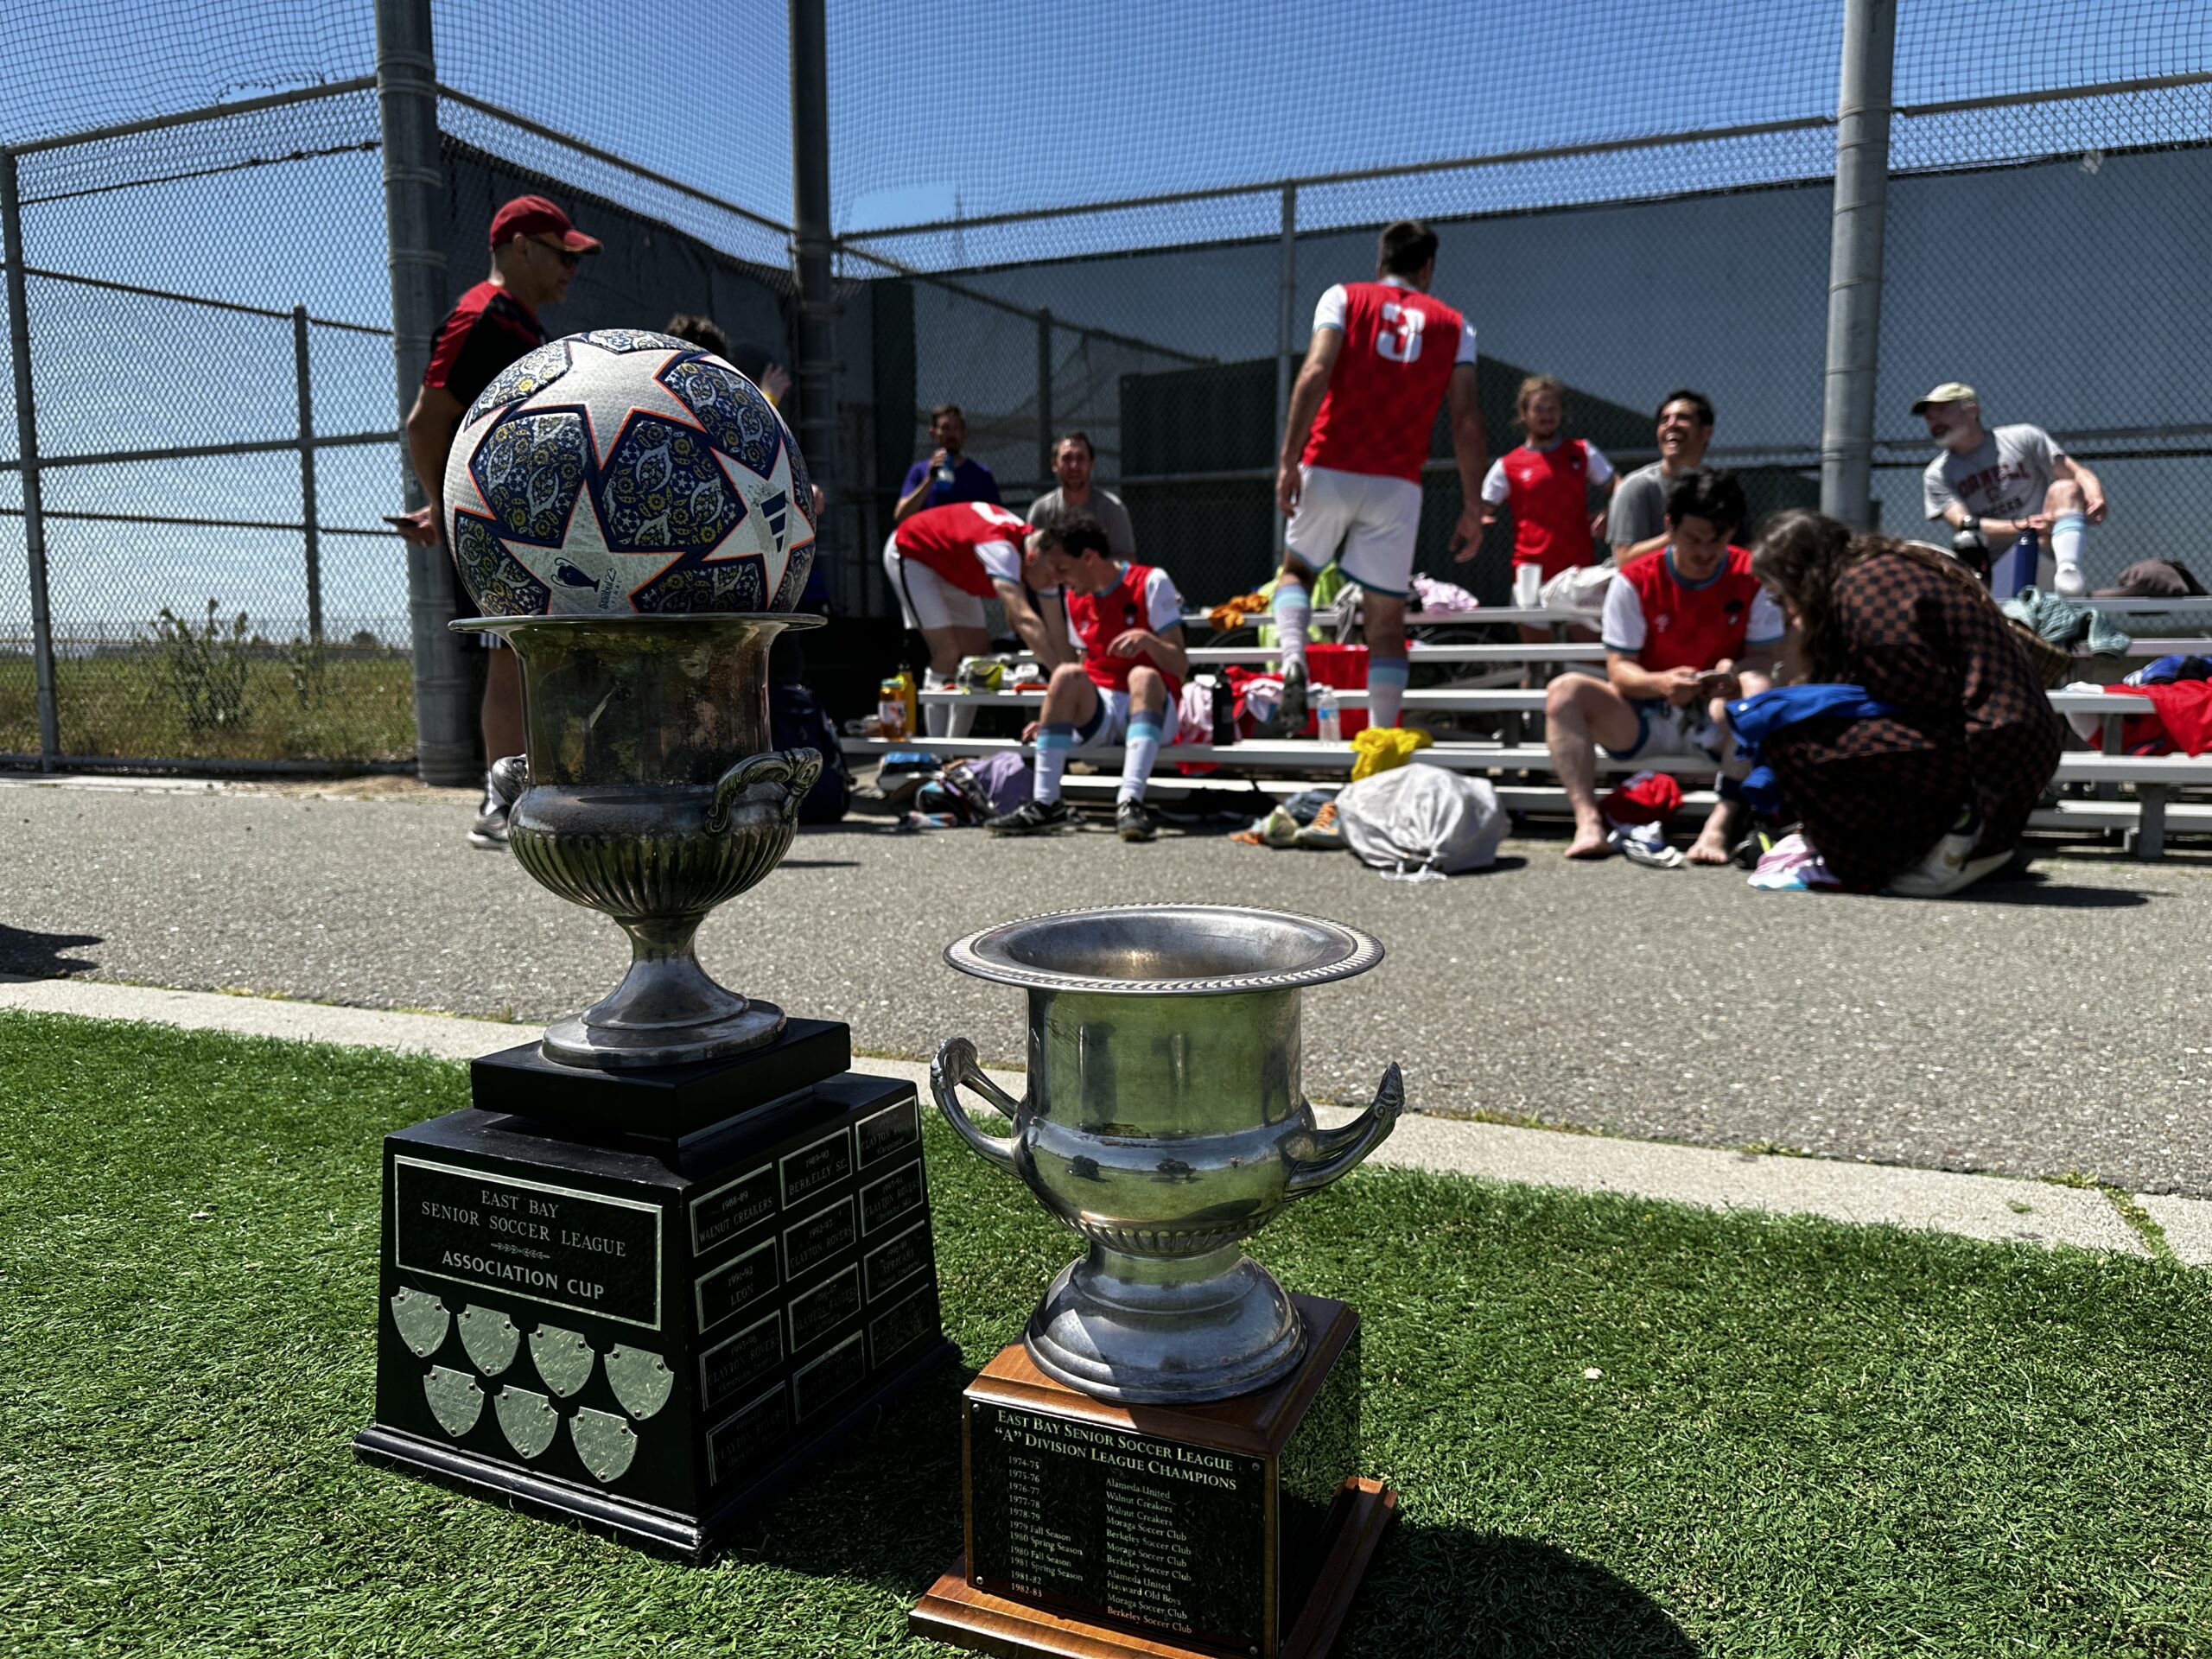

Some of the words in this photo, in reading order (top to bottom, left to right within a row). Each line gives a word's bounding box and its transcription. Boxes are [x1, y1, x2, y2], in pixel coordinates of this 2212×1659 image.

[1376, 301, 1426, 363] 3
[610, 580, 622, 604] FINAL
[861, 1130, 890, 1151] CLAYTON
[805, 1149, 830, 1168] 1989-90
[788, 1165, 832, 1197] BERKELEY
[481, 1190, 519, 1211] EAST
[529, 1198, 559, 1218] BAY
[721, 1190, 748, 1211] 1988-89
[865, 1194, 894, 1217] CLAYTON
[896, 1179, 920, 1199] ROVERS
[422, 1201, 480, 1227] SENIOR
[489, 1215, 550, 1241] SOCCER
[562, 1230, 626, 1257] LEAGUE
[698, 1217, 730, 1243] WALNUT
[733, 1196, 773, 1226] CREAKERS
[809, 1219, 833, 1239] 1992-93
[789, 1243, 823, 1269] CLAYTON
[825, 1225, 853, 1249] ROVERS
[442, 1250, 558, 1290] ASSOCIATION
[567, 1279, 604, 1300] CUP
[728, 1265, 753, 1287] 1991-92
[730, 1285, 754, 1306] LEON
[708, 1356, 745, 1387] CLAYTON
[750, 1337, 780, 1361] ROVERS
[997, 1409, 1029, 1428] EAST
[1033, 1415, 1061, 1435] BAY
[1064, 1423, 1115, 1448] SENIOR
[1117, 1435, 1173, 1459] SOCCER
[1176, 1447, 1233, 1471] LEAGUE
[1008, 1455, 1039, 1470] 1974-75
[1025, 1433, 1087, 1459] DIVISION
[1090, 1447, 1144, 1471] LEAGUE
[1147, 1459, 1237, 1491] CHAMPIONS
[1009, 1469, 1040, 1483] 1975-76
[1009, 1482, 1039, 1495] 1976-77
[1106, 1478, 1141, 1493] Alameda
[1142, 1485, 1170, 1499] United
[1009, 1494, 1040, 1509] 1977-78
[1106, 1491, 1135, 1504] Walnut
[1136, 1497, 1173, 1514] Creakers
[1009, 1507, 1040, 1521] 1978-79
[1106, 1503, 1135, 1518] Walnut
[1136, 1510, 1173, 1527] Creakers
[1010, 1520, 1028, 1530] 1979
[1030, 1524, 1044, 1535] Fall
[1046, 1528, 1071, 1542] Season
[1106, 1516, 1135, 1532] Moraga
[1137, 1523, 1165, 1536] Soccer
[1166, 1529, 1187, 1541] Club
[1010, 1531, 1028, 1542] 1980
[1030, 1535, 1055, 1552] Spring
[1057, 1541, 1084, 1556] Season
[1106, 1529, 1140, 1547] Berkeley
[1142, 1537, 1169, 1550] Soccer
[1171, 1543, 1192, 1555] Club
[1010, 1545, 1029, 1556] 1980
[1031, 1550, 1045, 1560] Fall
[1046, 1554, 1071, 1567] Season
[1106, 1541, 1135, 1558] Moraga
[1138, 1550, 1165, 1563] Soccer
[1166, 1556, 1187, 1568] Club
[1011, 1556, 1028, 1567] 1981
[1031, 1560, 1056, 1577] Spring
[1057, 1567, 1084, 1581] Season
[1011, 1570, 1042, 1585] 1981-82
[1106, 1554, 1140, 1573] Berkeley
[1142, 1563, 1169, 1577] Soccer
[1172, 1570, 1192, 1582] Club
[1011, 1582, 1042, 1597] 1982-83
[1107, 1569, 1141, 1584] Alameda
[1143, 1578, 1171, 1592] United
[1107, 1580, 1142, 1596] Hayward
[1144, 1589, 1160, 1600] Old
[1162, 1593, 1181, 1607] Boys
[1107, 1593, 1136, 1610] Moraga
[1138, 1601, 1166, 1614] Soccer
[1167, 1607, 1187, 1619] Club
[1107, 1605, 1141, 1624] Berkeley
[1143, 1614, 1170, 1628] Soccer
[1172, 1622, 1192, 1634] Club
